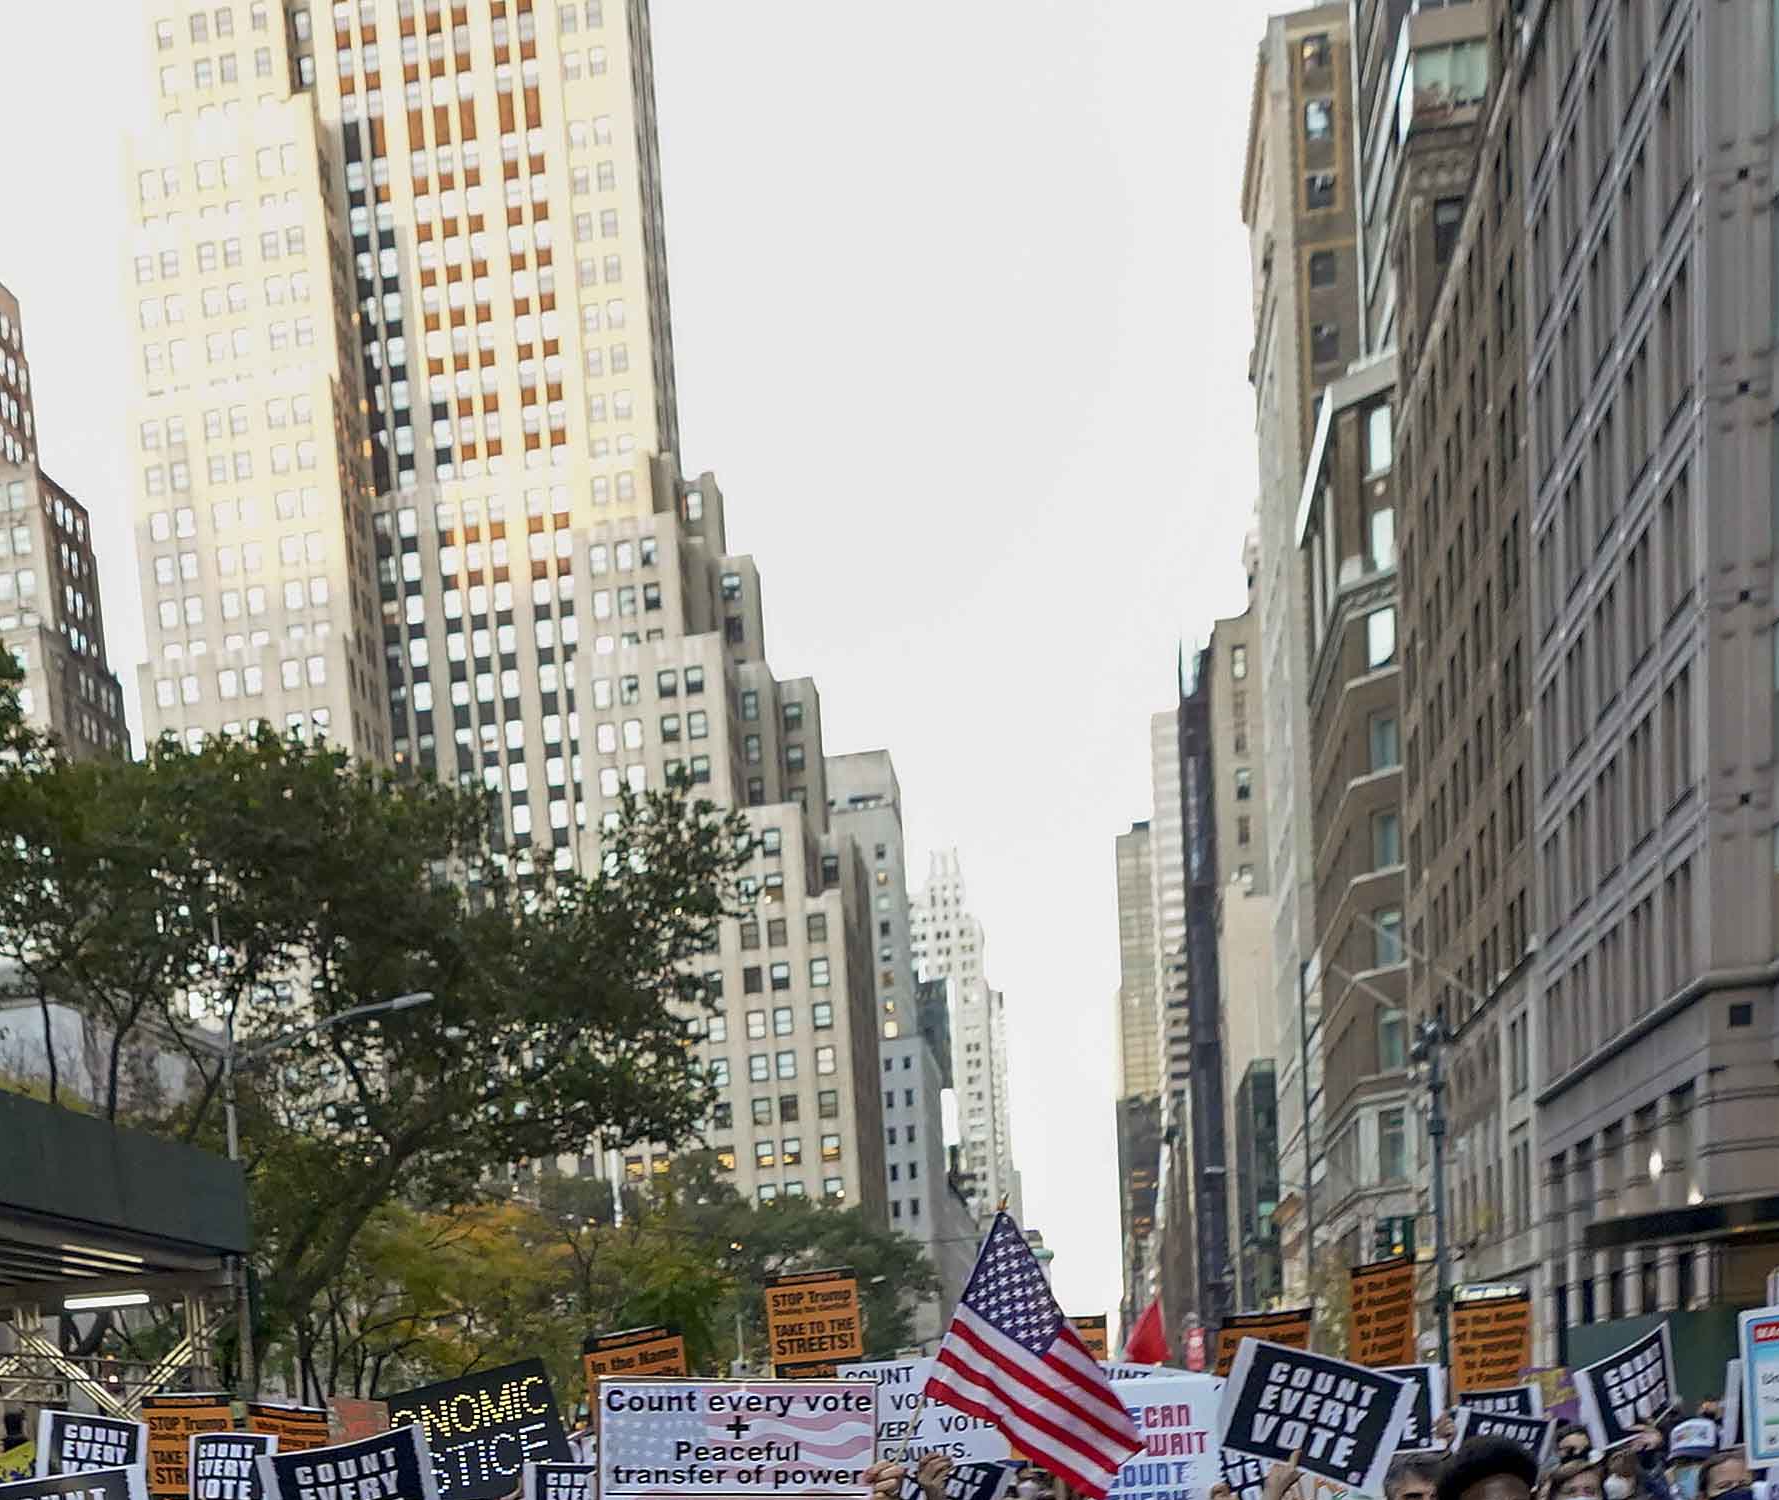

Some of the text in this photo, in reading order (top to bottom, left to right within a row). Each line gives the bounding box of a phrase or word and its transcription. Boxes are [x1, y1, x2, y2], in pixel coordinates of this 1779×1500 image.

[772, 1292, 804, 1307] STOP
[773, 1317, 855, 1337] TAKE TO THE
[775, 1333, 856, 1355] STREETS!
[591, 1347, 678, 1374] In the Name
[1270, 1362, 1378, 1408] COUNT
[605, 1390, 872, 1418] Count every vote
[1259, 1384, 1369, 1434] EVERY
[64, 1424, 129, 1445] COUNT
[149, 1417, 181, 1431] STOP
[63, 1441, 127, 1463] EVERY
[198, 1443, 255, 1459] COUNT
[675, 1440, 800, 1462] Peaceful
[1147, 1432, 1207, 1456] WAIT
[1250, 1413, 1358, 1470] VOTE
[153, 1451, 182, 1465] TAKE
[197, 1459, 253, 1478] EVERY
[295, 1448, 396, 1486] COUNT
[614, 1463, 863, 1489] transfer of power
[197, 1479, 252, 1500] VOTE
